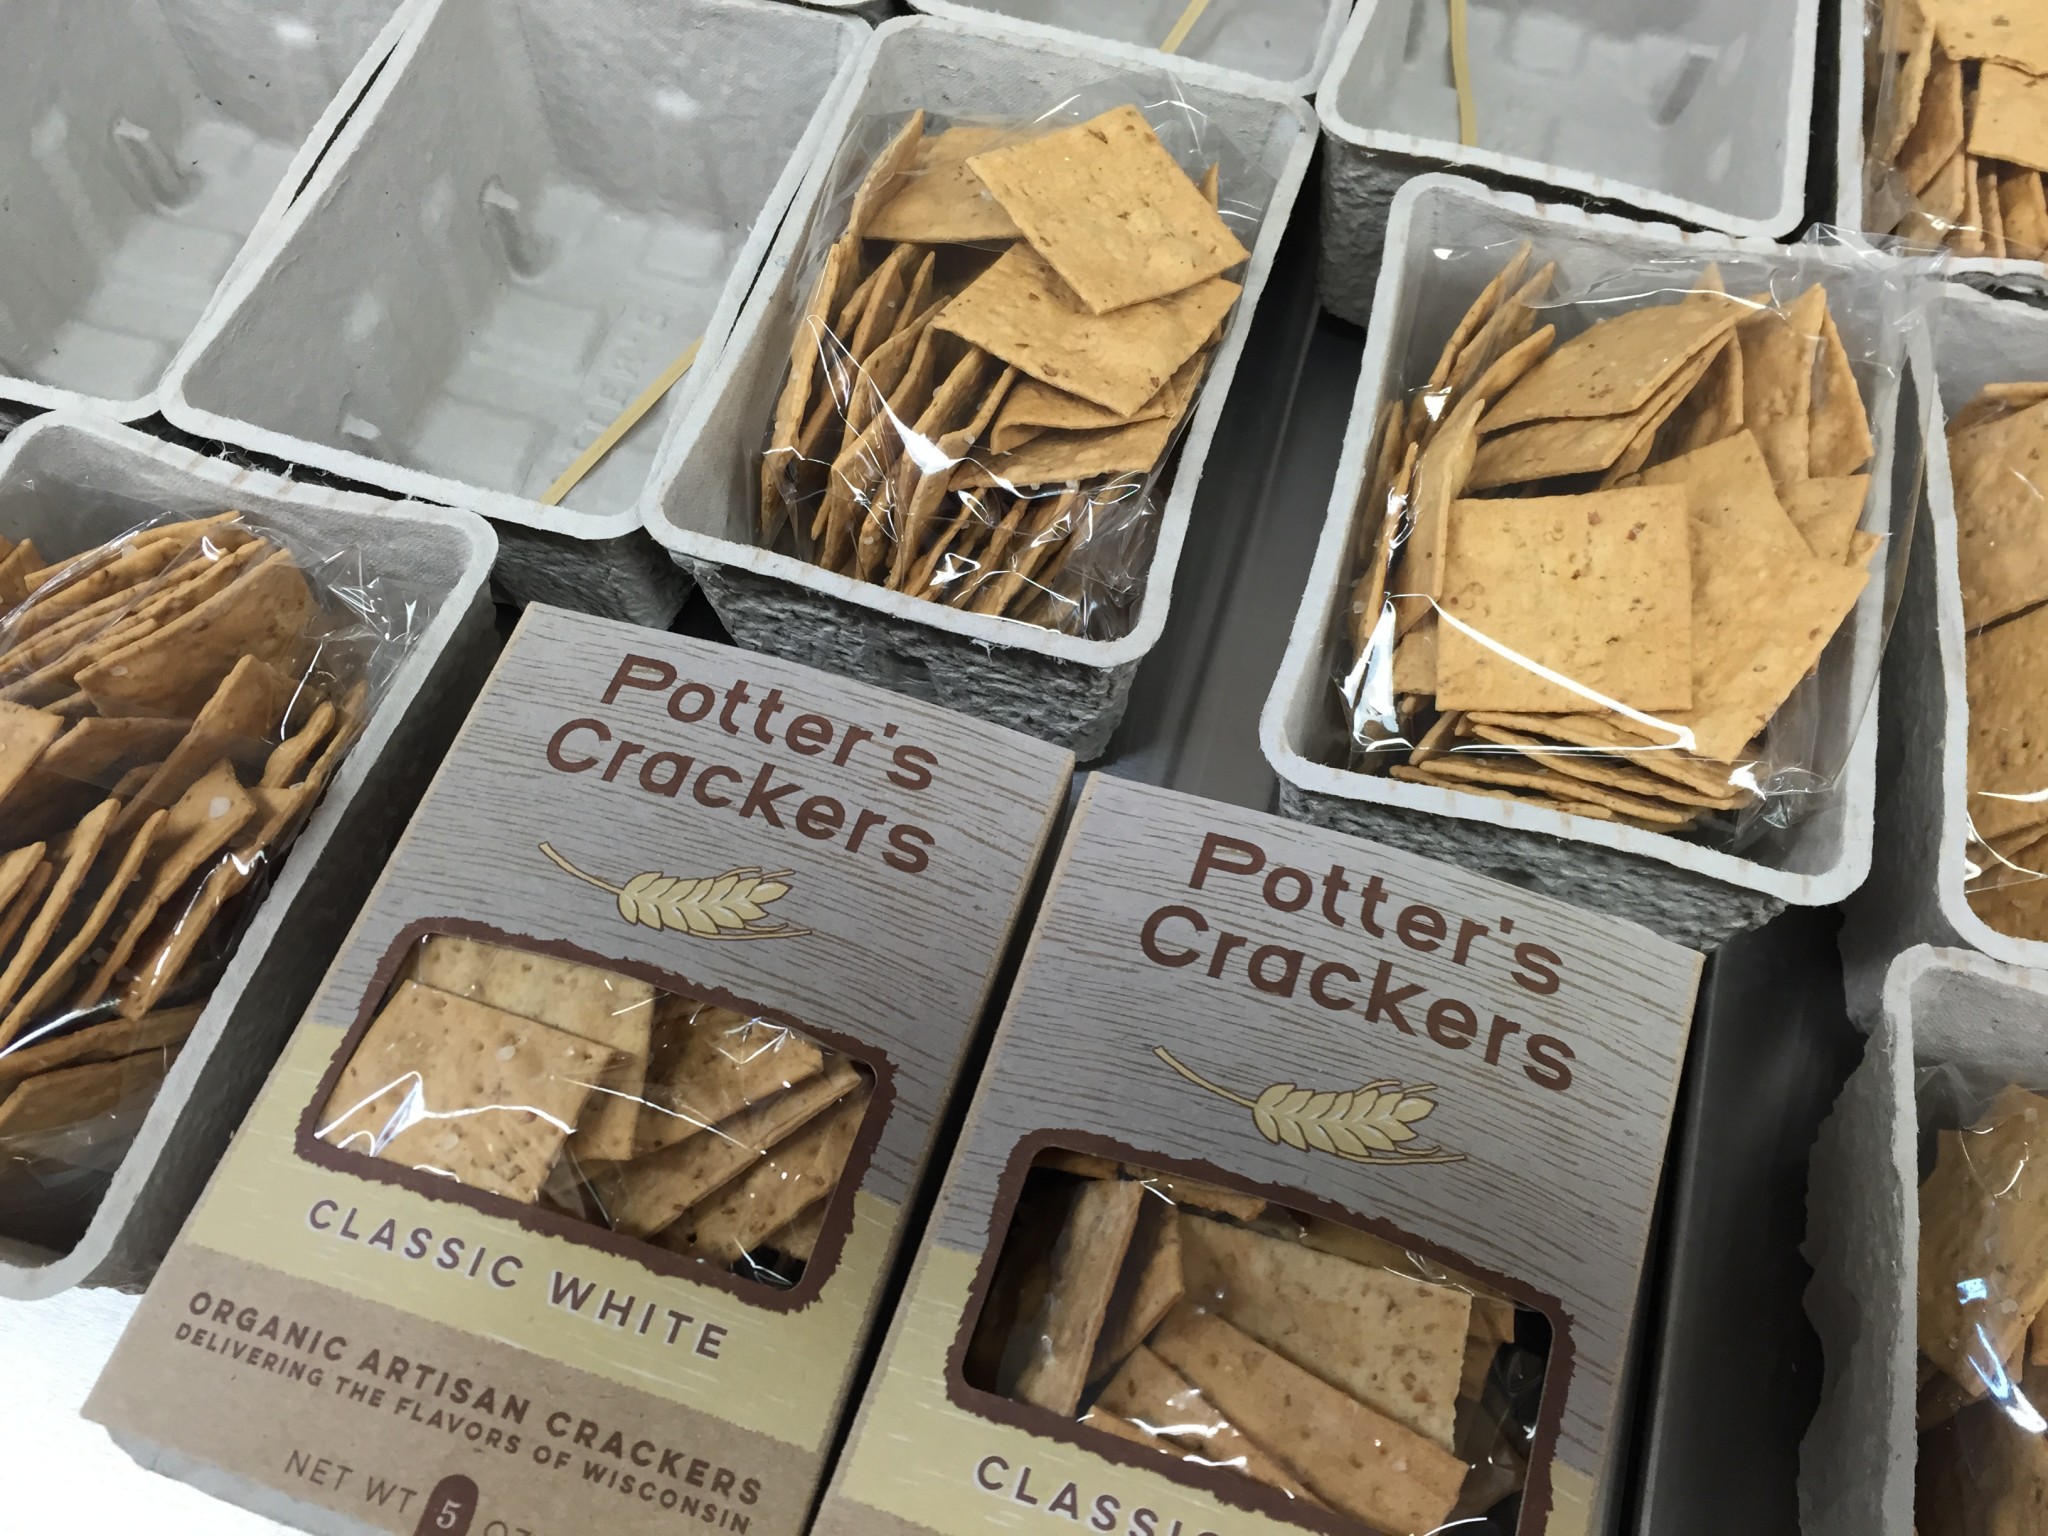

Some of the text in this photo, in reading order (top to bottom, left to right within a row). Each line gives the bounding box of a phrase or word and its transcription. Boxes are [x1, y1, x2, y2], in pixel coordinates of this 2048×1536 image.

[546, 718, 936, 873] Crackers
[601, 653, 939, 791] Potter's
[1188, 832, 1564, 995] Potter's
[1140, 905, 1576, 1092] Crackers
[308, 1199, 729, 1360] CLASSIC WHITE
[174, 1322, 751, 1535] DELIVERING THE FLAVORS OF WISCONSIN
[188, 1291, 762, 1506] ORGANIC ARTISAN CRACKERS
[284, 1449, 354, 1491] NET
[365, 1476, 418, 1514] WT
[435, 1499, 463, 1530] 5
[976, 1455, 1220, 1536] CLASS
